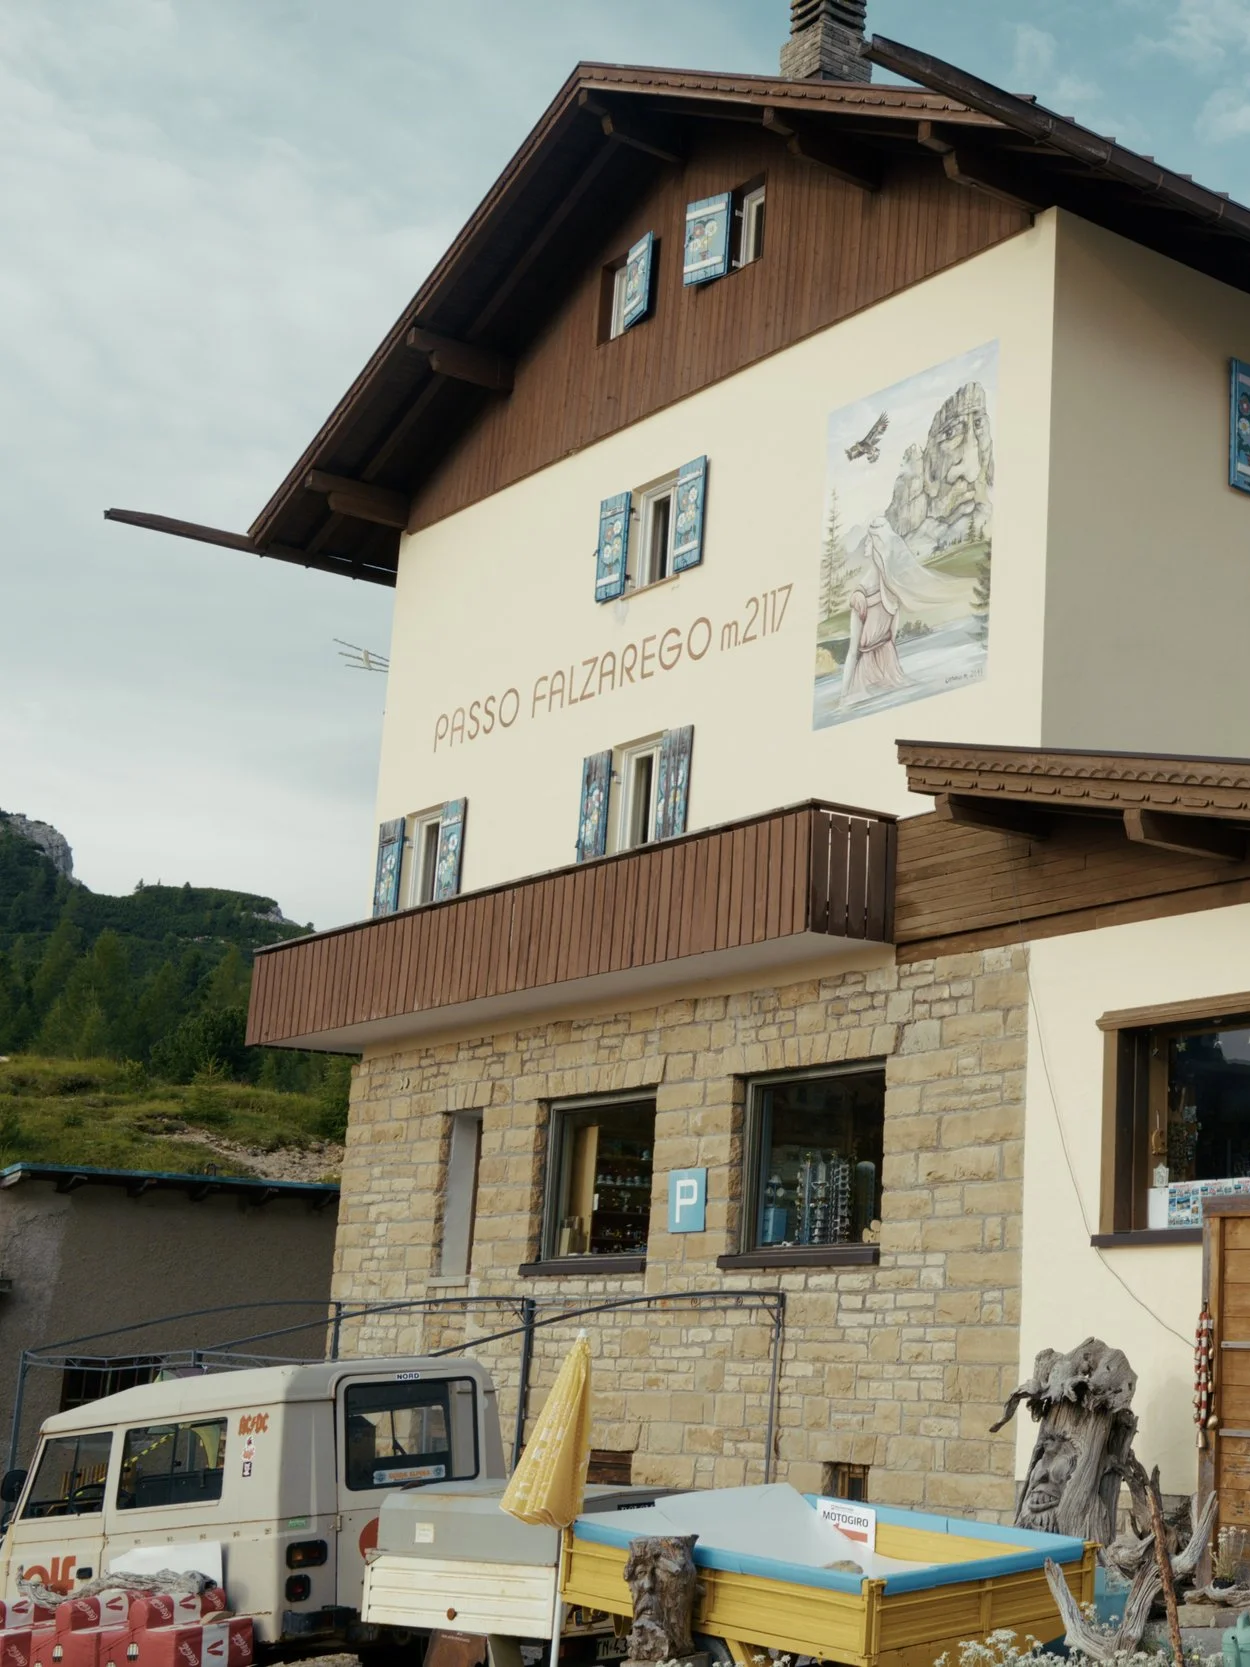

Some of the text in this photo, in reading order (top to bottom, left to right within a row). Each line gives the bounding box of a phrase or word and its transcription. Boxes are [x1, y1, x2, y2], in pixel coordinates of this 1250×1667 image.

[433, 687, 520, 753] PASSO
[531, 616, 712, 719] FALZAREGO
[675, 1178, 699, 1224] P
[396, 1372, 420, 1380] NORD
[822, 1510, 869, 1528] MOTOGIRO
